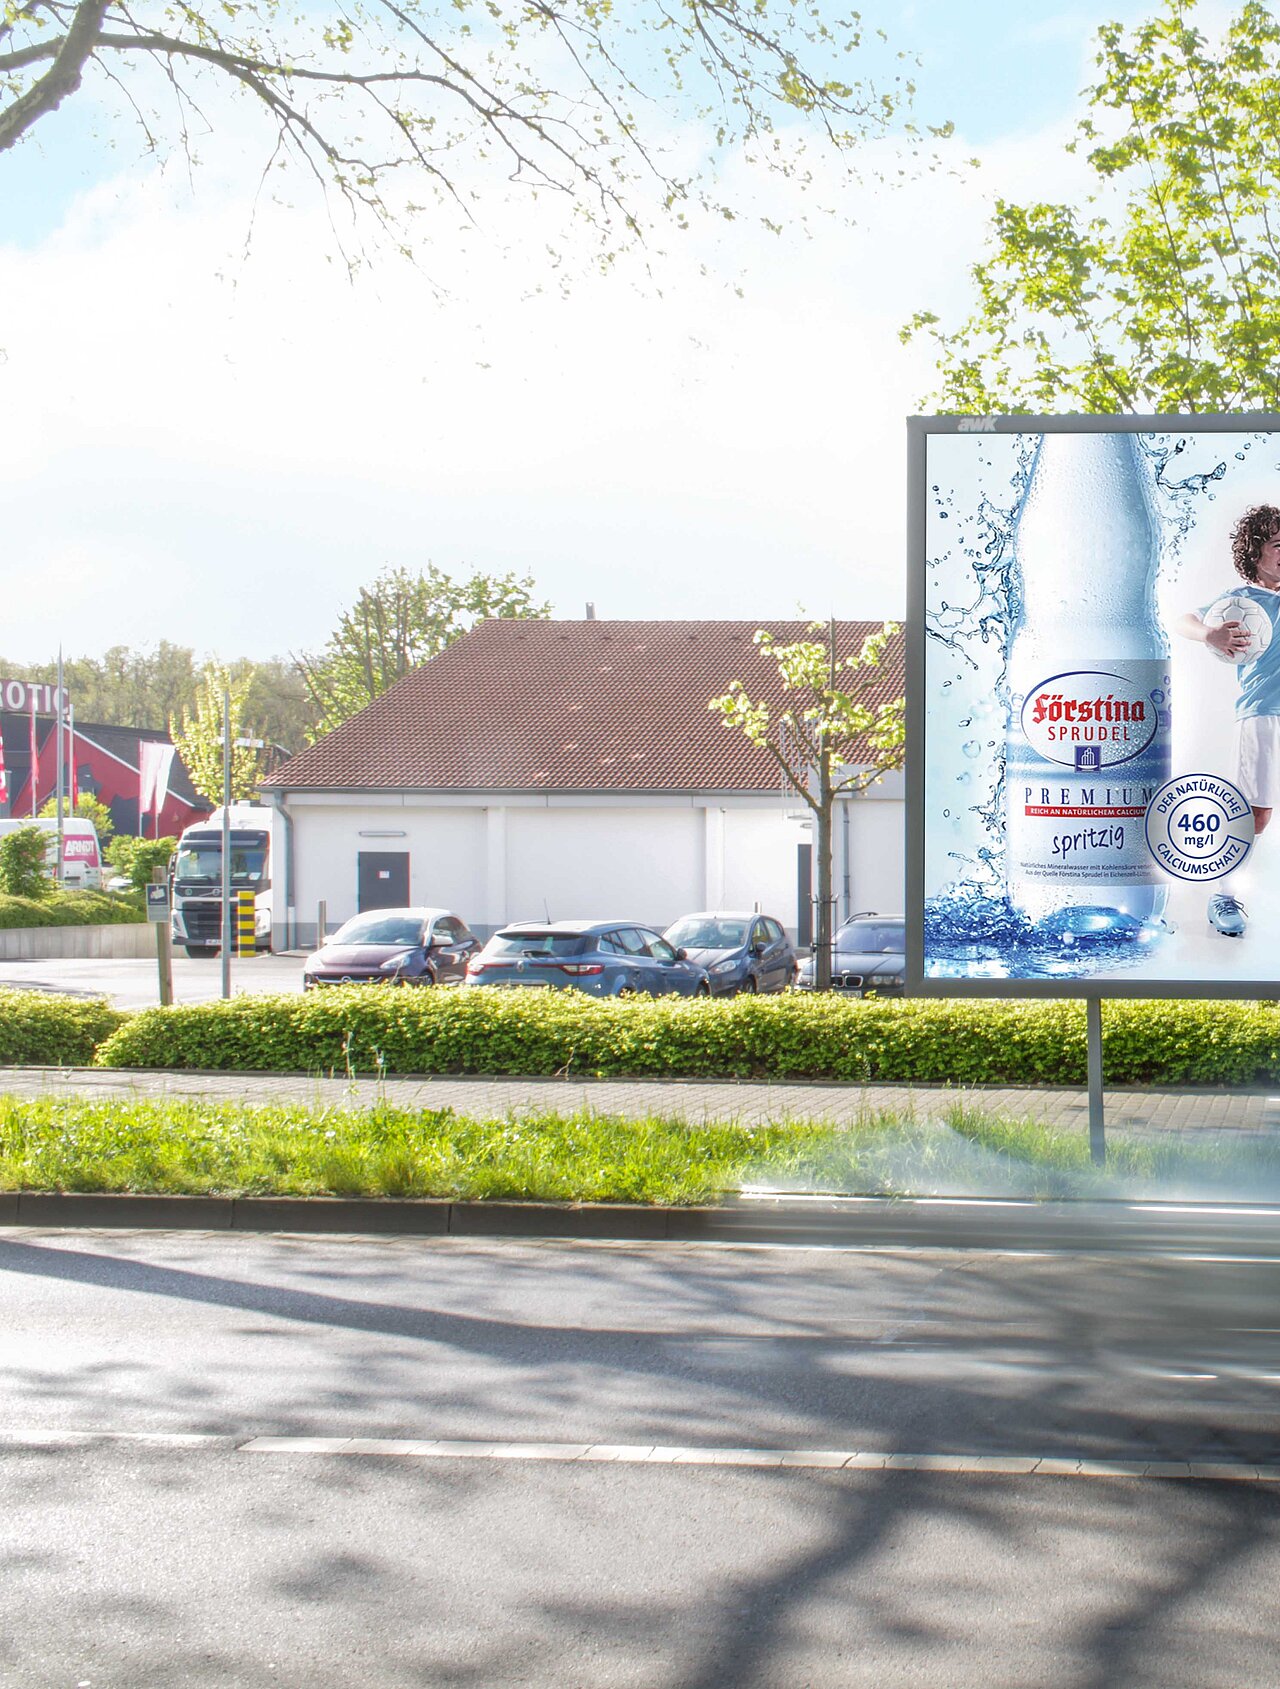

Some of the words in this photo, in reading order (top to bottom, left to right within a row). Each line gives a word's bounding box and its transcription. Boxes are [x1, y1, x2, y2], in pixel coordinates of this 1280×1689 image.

[957, 414, 997, 432] awk
[0, 681, 68, 715] OTIC
[1032, 693, 1146, 724] Förstina
[1048, 726, 1131, 741] SPRUDEL
[1025, 787, 1153, 805] PREMIUM
[1157, 792, 1177, 814] DER
[1175, 779, 1242, 815] NATÜRLICHE
[1030, 807, 1049, 815] REICH
[1062, 806, 1115, 816] NATÜRLICHEM
[1116, 808, 1146, 816] CALCIUM
[1177, 814, 1220, 832] 460
[1052, 825, 1124, 859] spritzig
[1184, 834, 1214, 848] mg/l
[1157, 843, 1240, 874] CALCIUMSCHATZ
